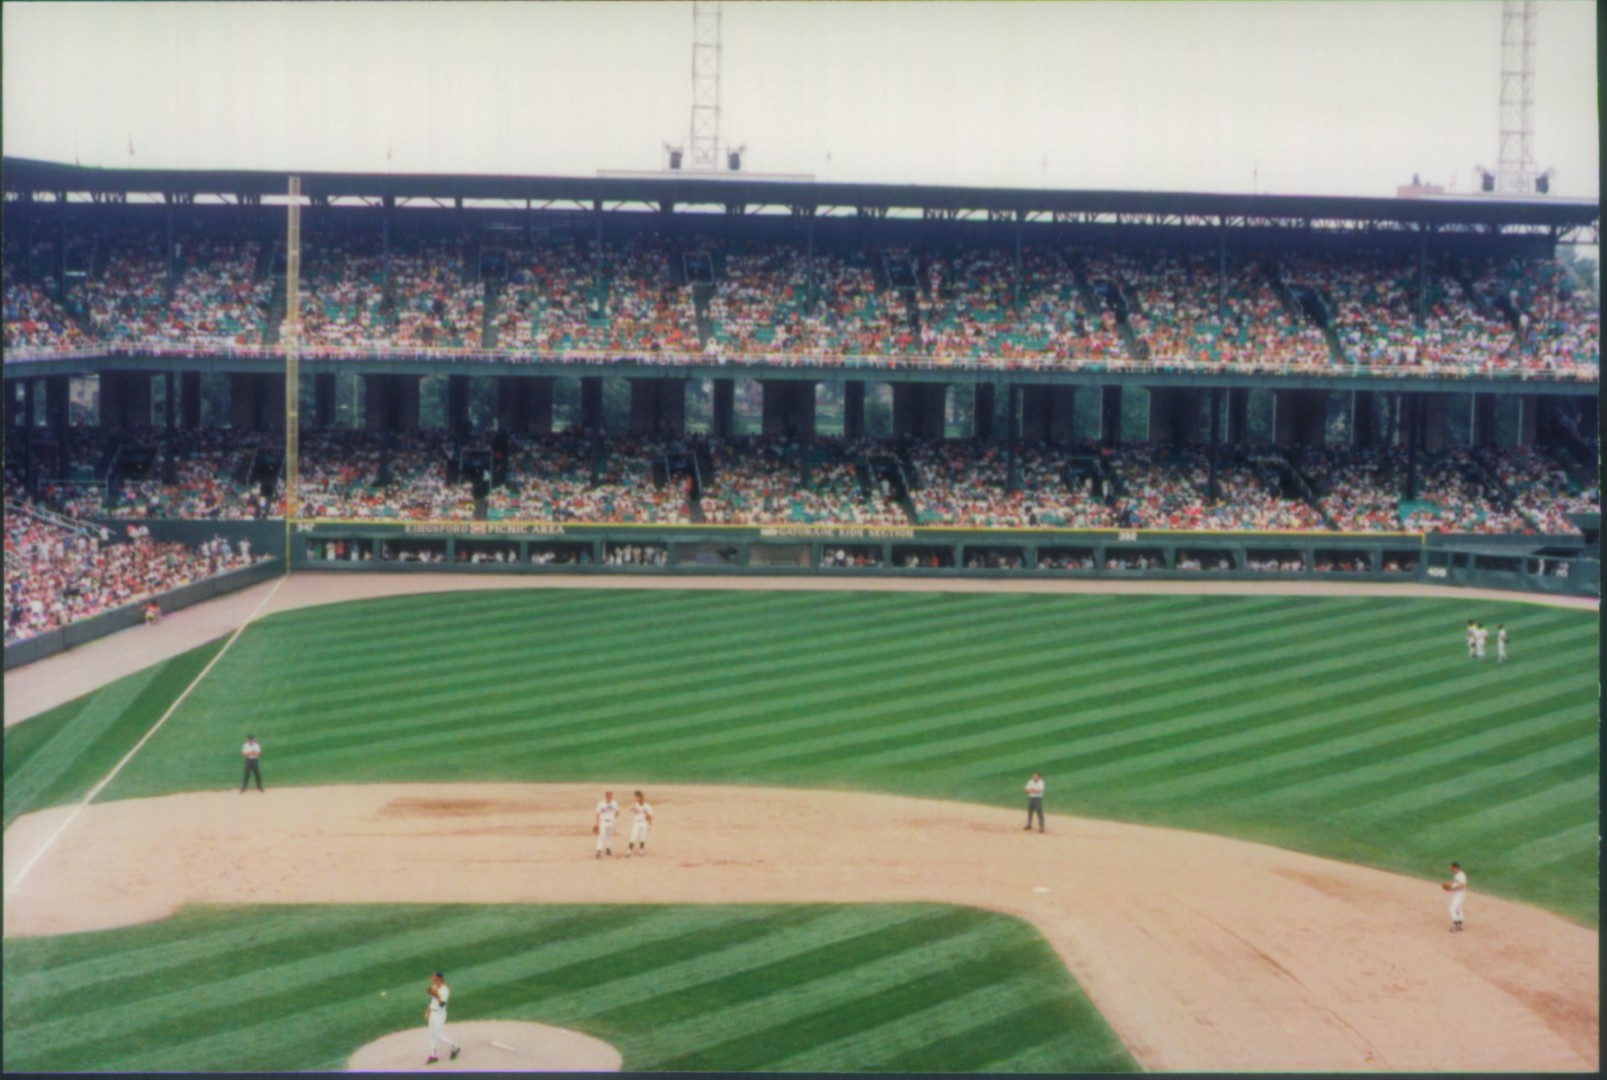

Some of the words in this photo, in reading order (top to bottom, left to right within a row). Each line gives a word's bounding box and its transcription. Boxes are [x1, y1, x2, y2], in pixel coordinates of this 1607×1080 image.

[405, 523, 469, 534] KINGSFORD
[487, 523, 528, 534] PICNIC
[532, 524, 565, 535] AREA
[778, 528, 835, 537] GATORADE
[839, 528, 864, 537] KIDS
[869, 529, 914, 538] SECTION
